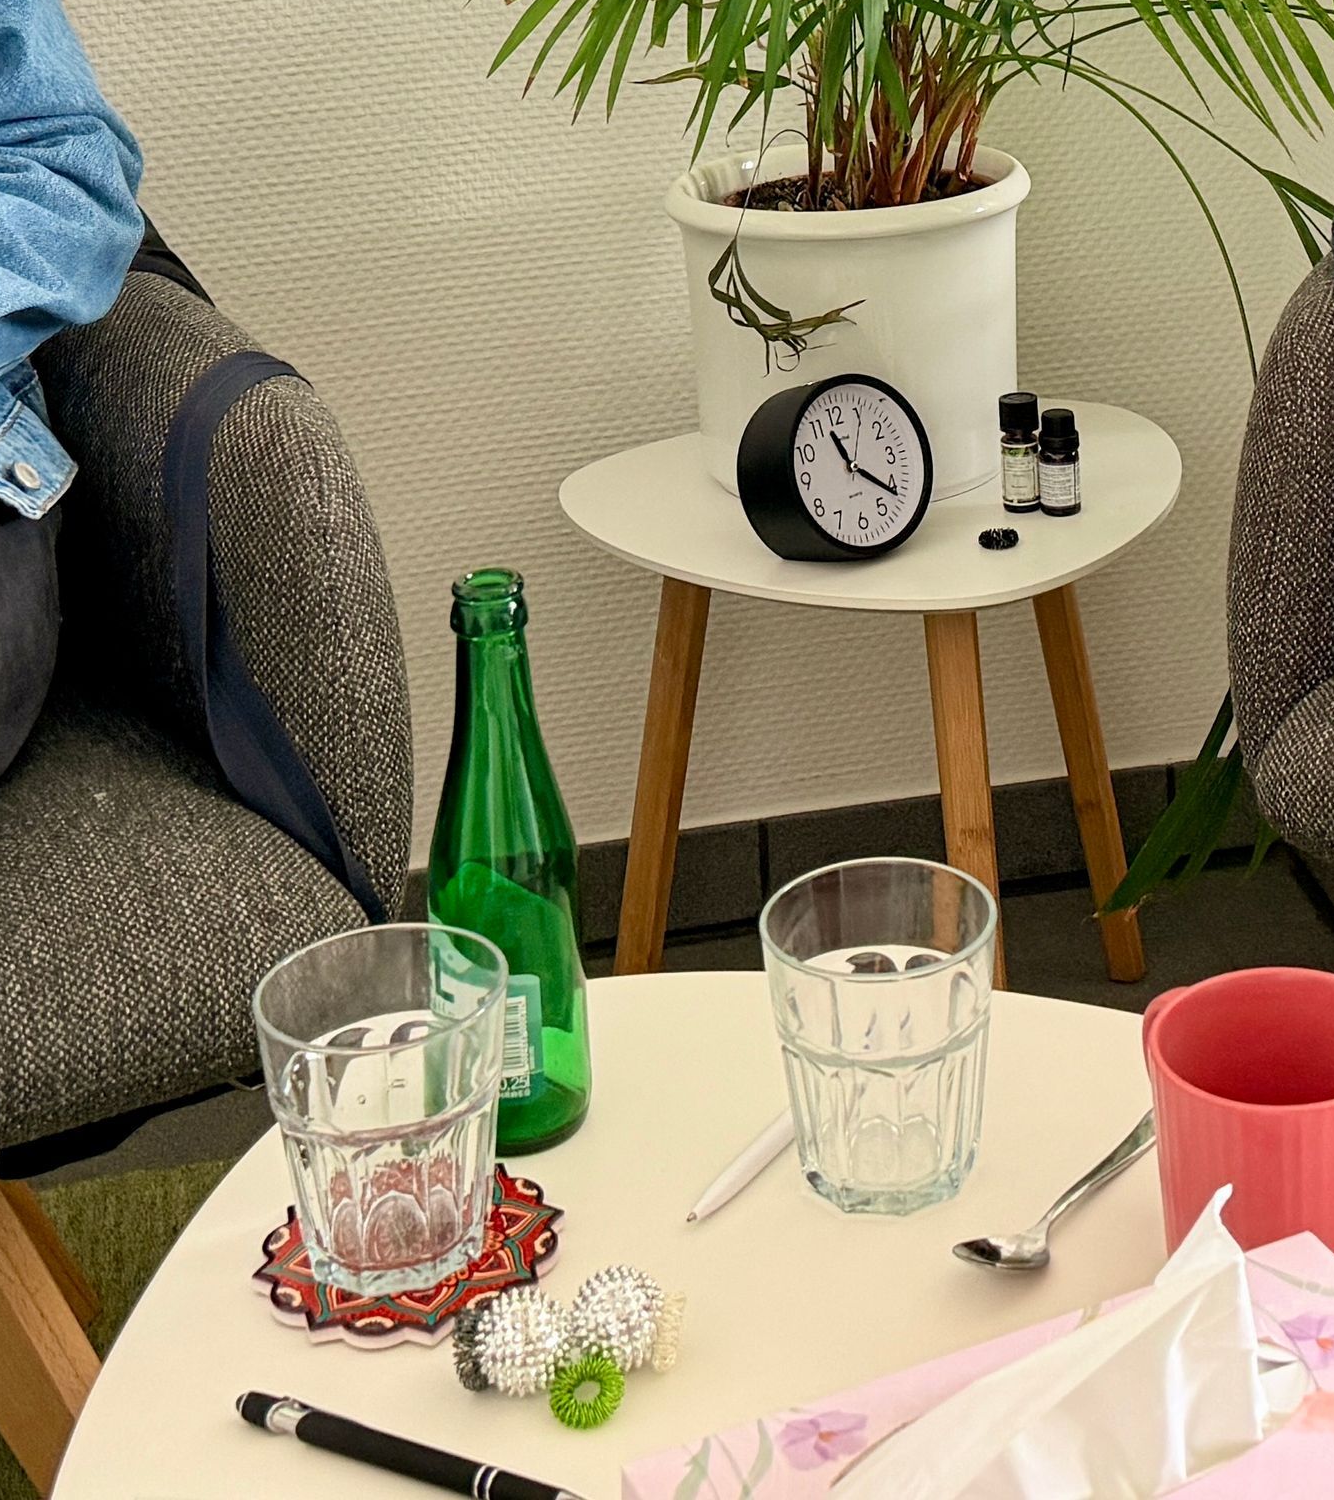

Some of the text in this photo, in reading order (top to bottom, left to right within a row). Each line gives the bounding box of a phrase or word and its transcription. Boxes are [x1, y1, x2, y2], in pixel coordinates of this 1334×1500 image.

[825, 406, 844, 426] 12
[852, 407, 862, 427] 1
[809, 419, 825, 440] 11
[871, 421, 885, 441] 2
[796, 443, 816, 465] 10
[885, 446, 896, 465] 3
[800, 471, 812, 491] 9
[888, 473, 898, 493] 4
[814, 498, 825, 517] 8
[876, 497, 888, 517] 5
[833, 510, 842, 530] 7
[858, 511, 869, 530] 6
